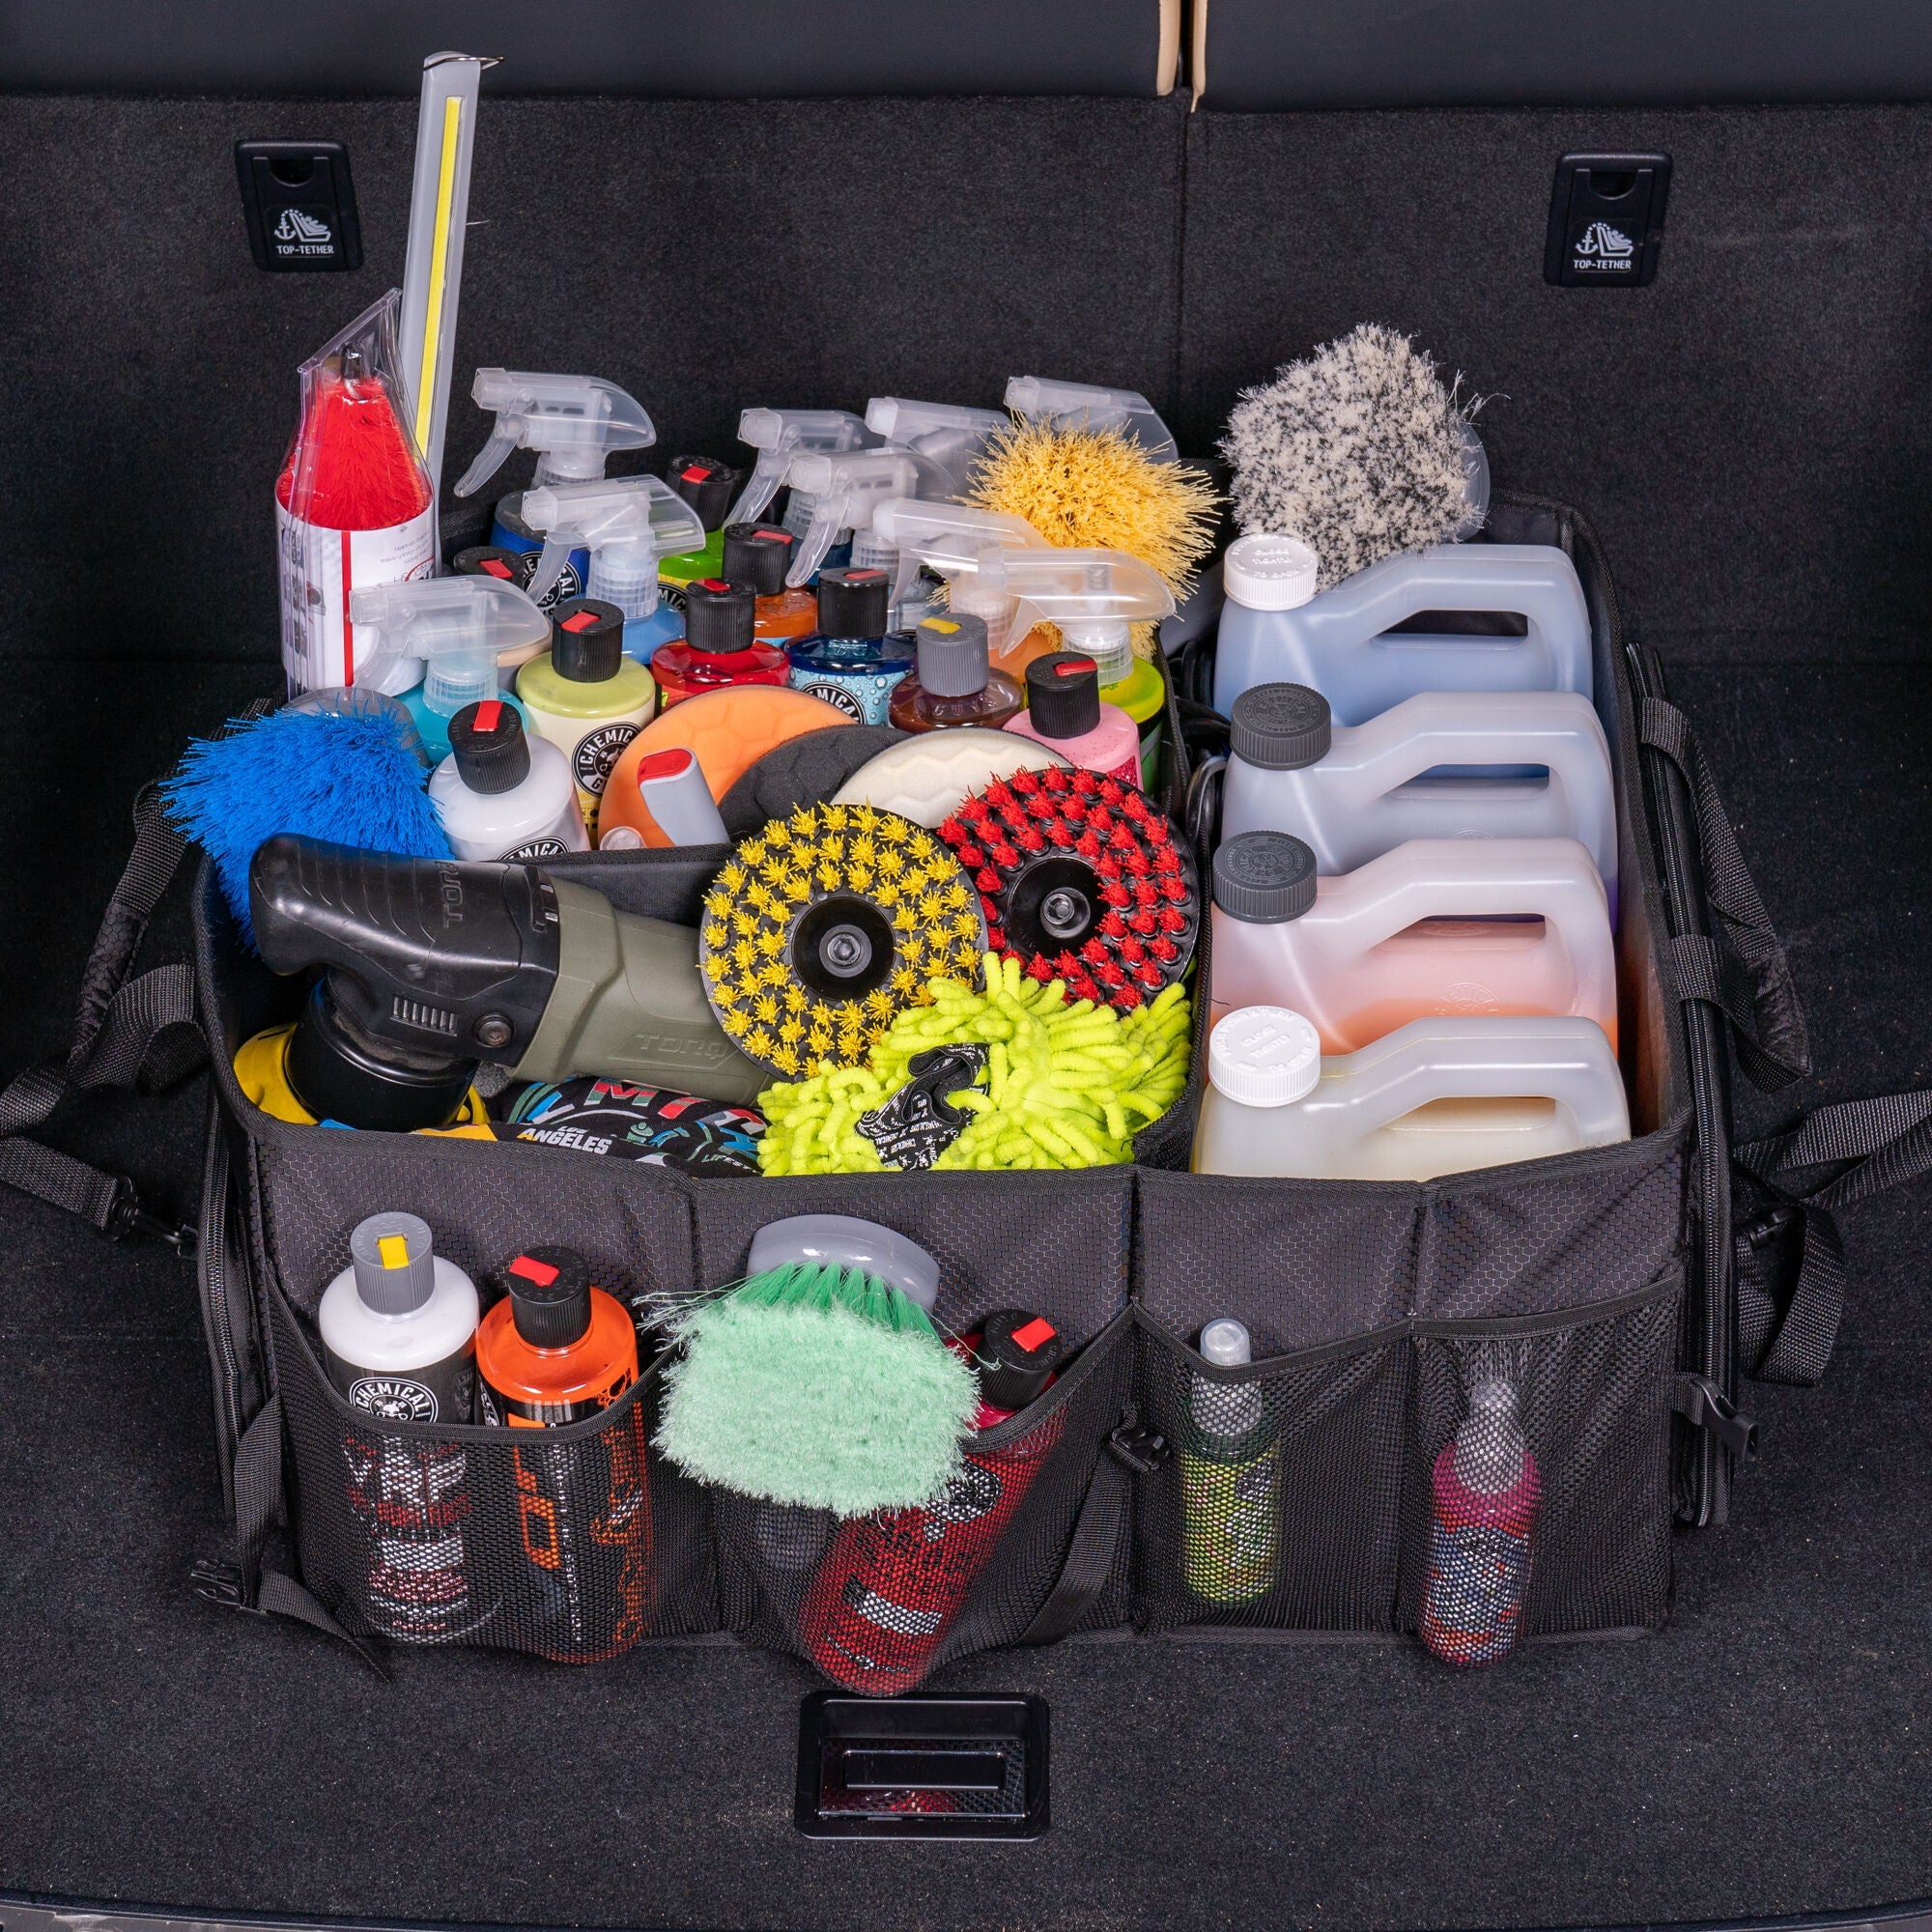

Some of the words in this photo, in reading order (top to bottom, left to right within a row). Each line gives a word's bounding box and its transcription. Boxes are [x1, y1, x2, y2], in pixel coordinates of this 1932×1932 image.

[276, 245, 334, 254] TOP-TETHER
[1573, 259, 1632, 270] TOP-TETHER
[580, 729, 633, 764] CHEMIC
[637, 1035, 727, 1060] TORQ
[517, 1127, 612, 1155] ANGELES
[355, 1382, 431, 1412] CHEMICAL
